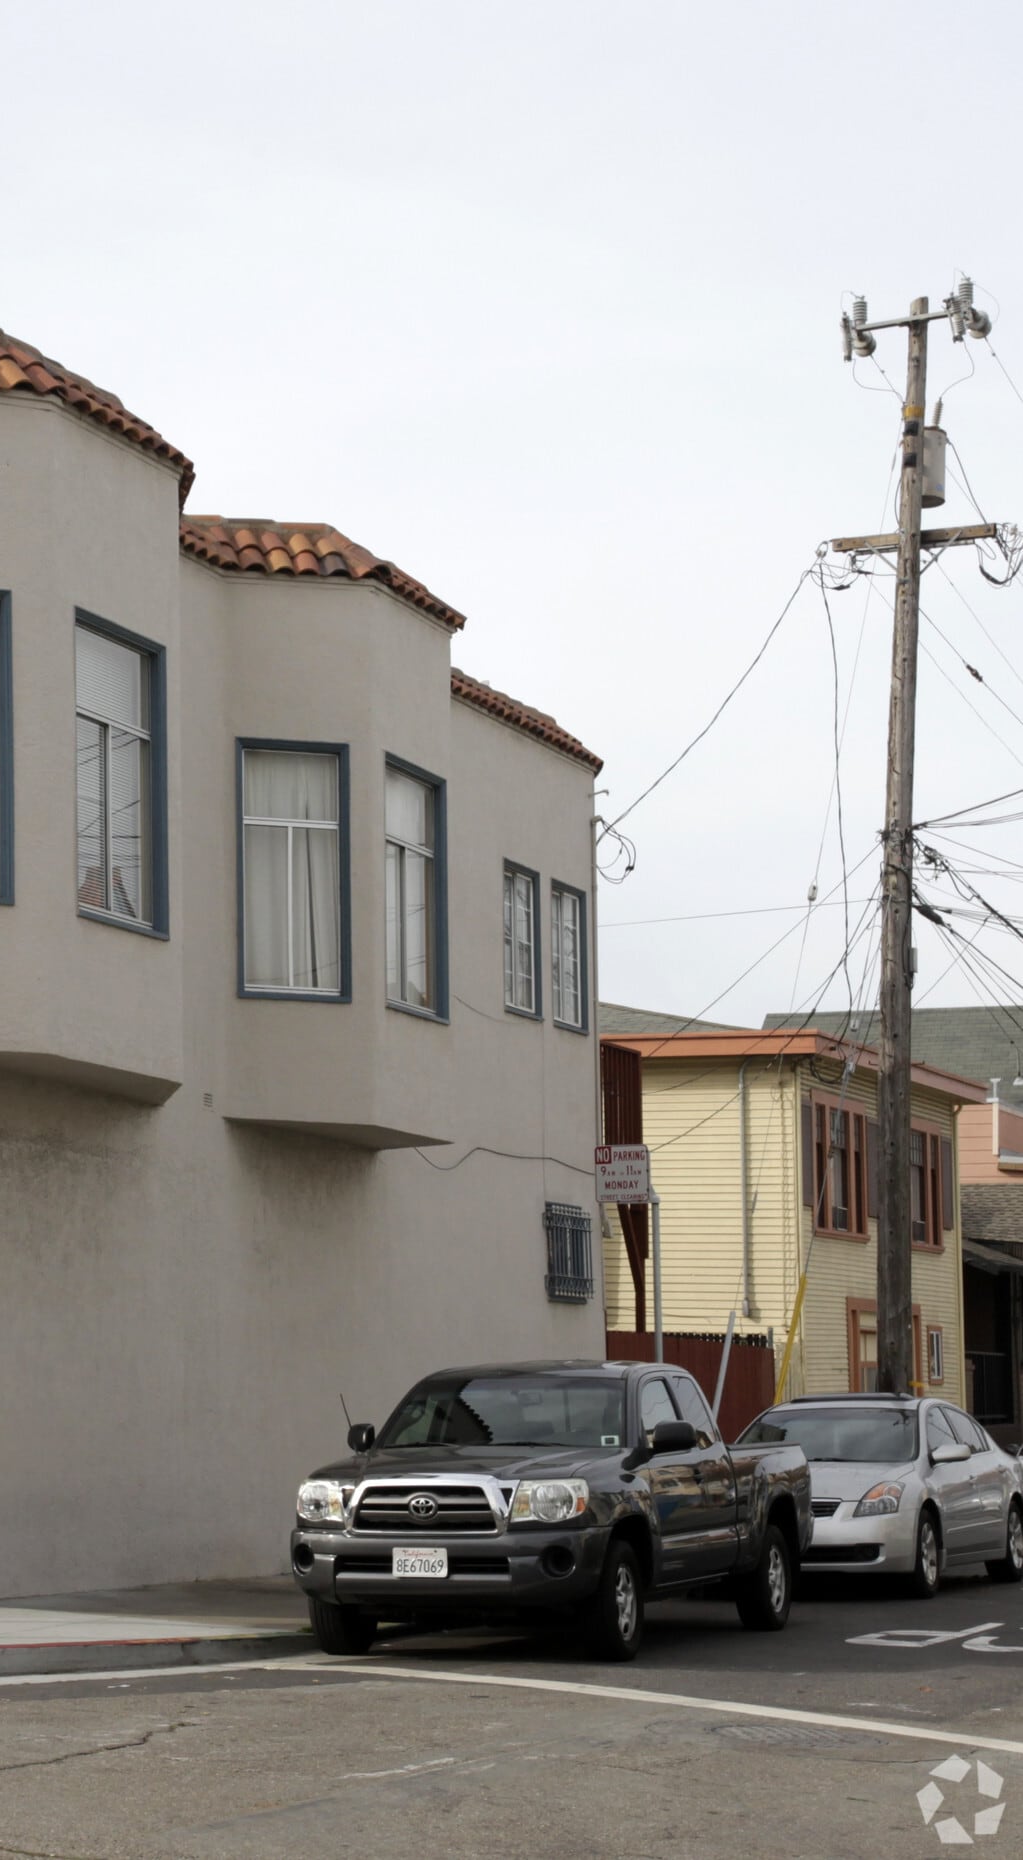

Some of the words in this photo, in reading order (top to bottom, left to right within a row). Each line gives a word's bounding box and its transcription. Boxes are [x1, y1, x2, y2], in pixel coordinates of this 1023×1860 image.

[596, 1148, 610, 1162] NO
[613, 1150, 646, 1161] PARKING
[605, 1180, 639, 1190] MONDAY
[396, 1558, 444, 1574] 8E67069
